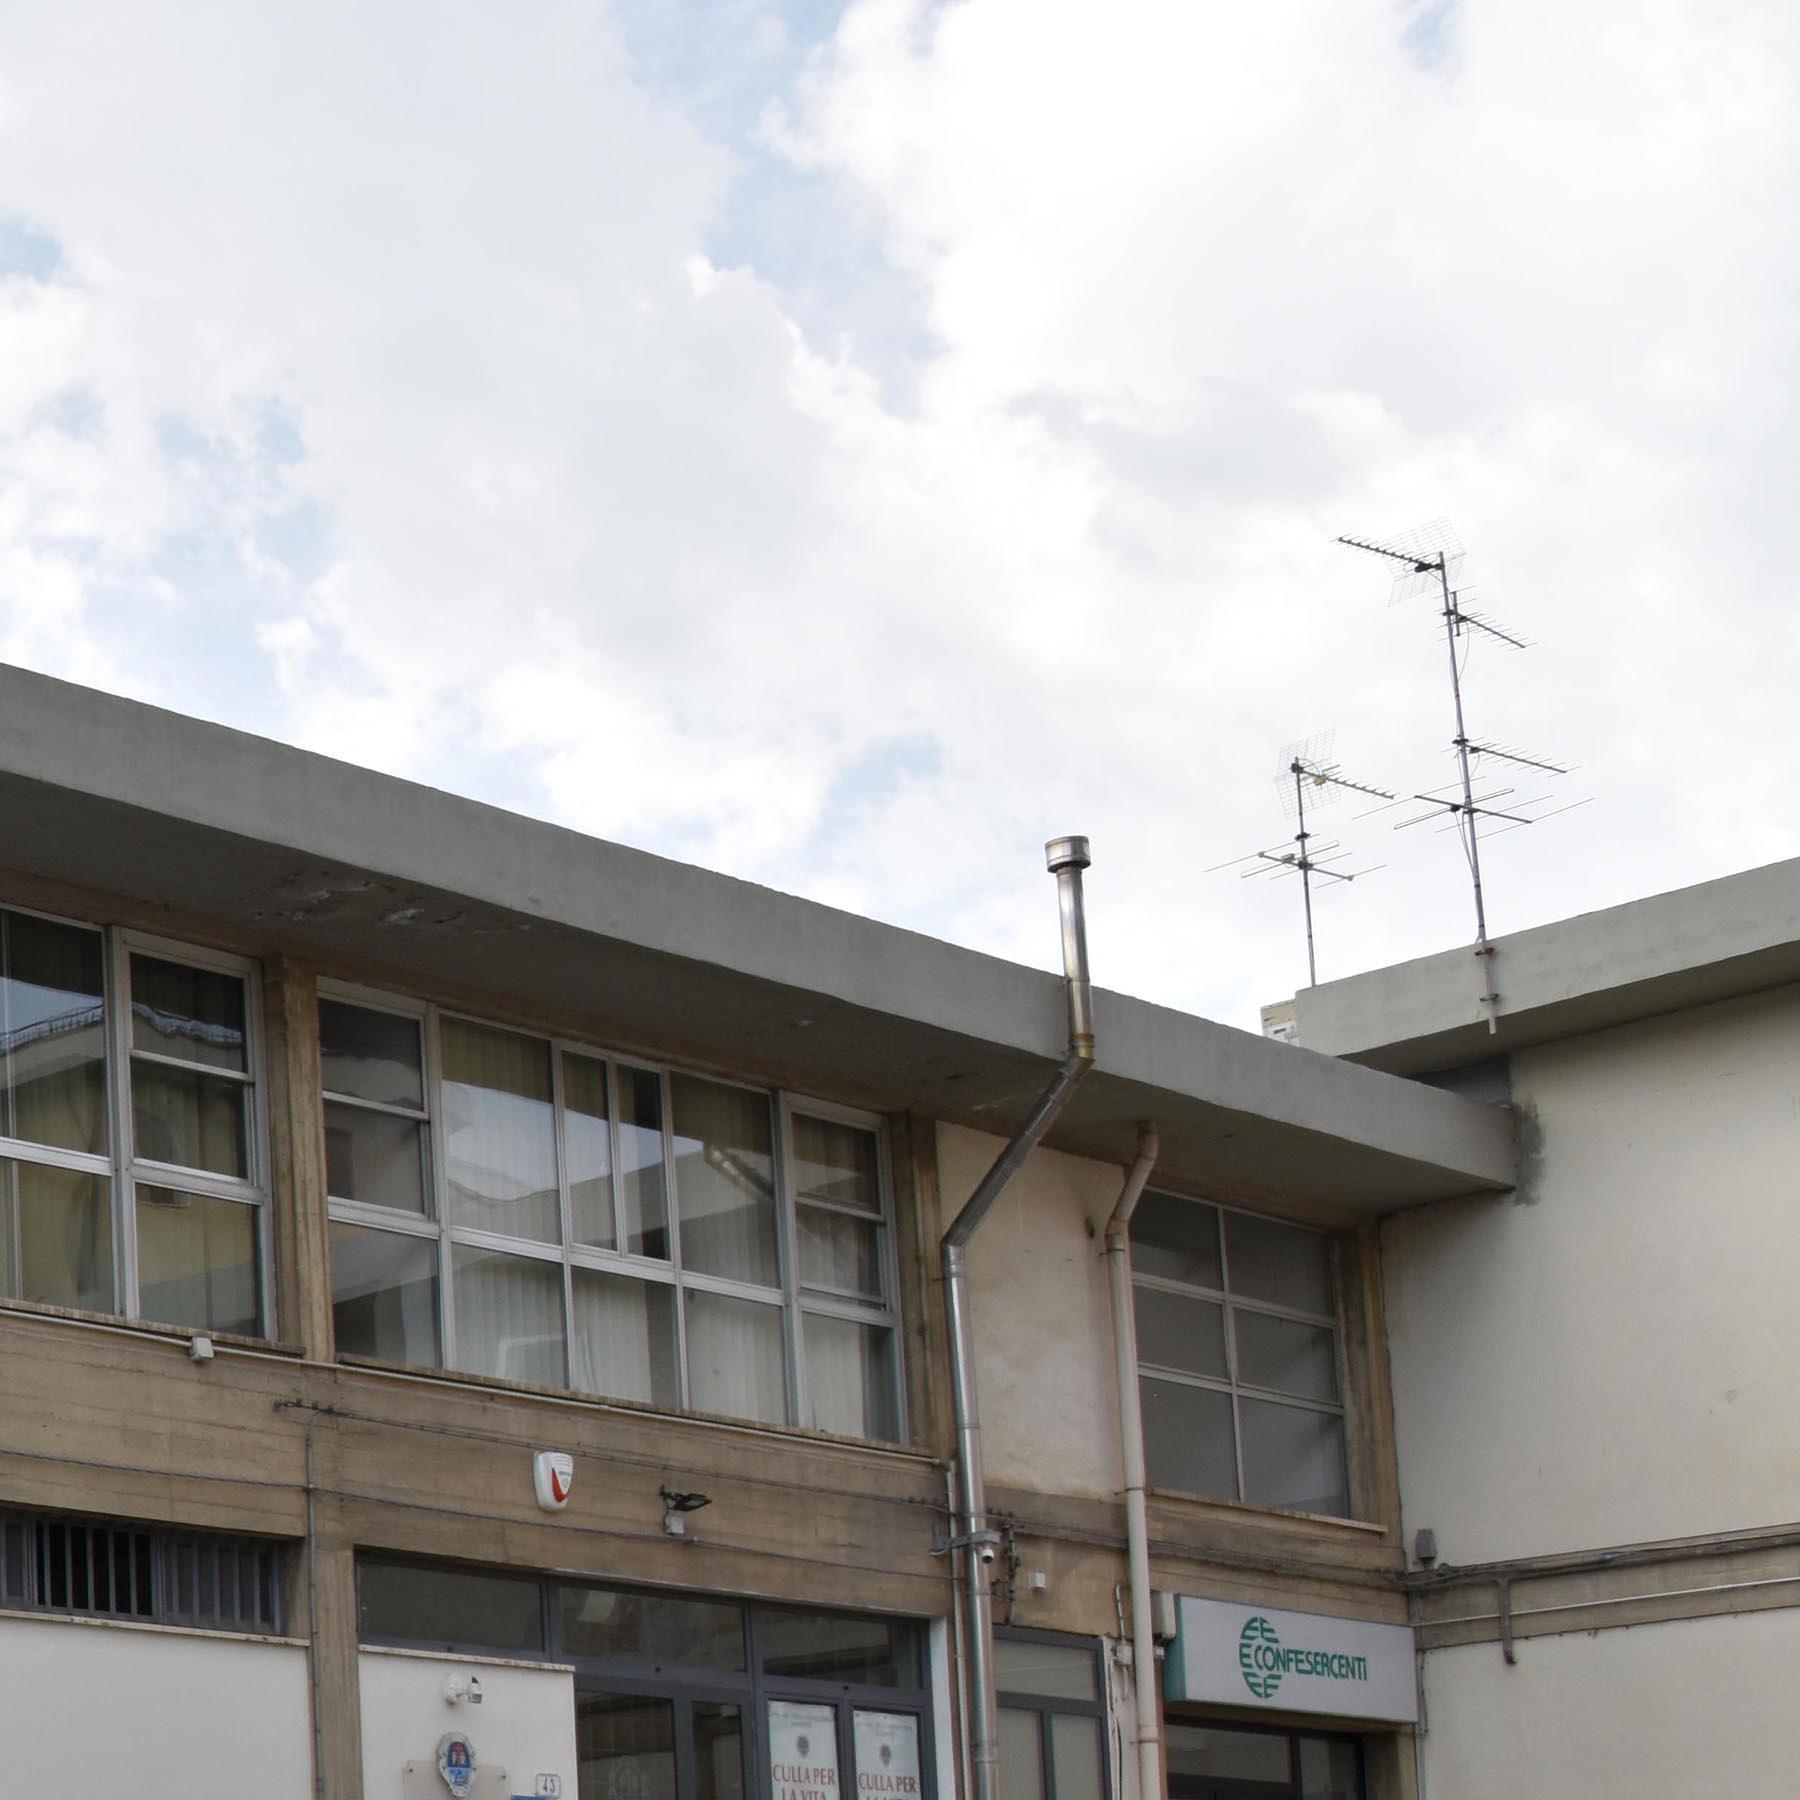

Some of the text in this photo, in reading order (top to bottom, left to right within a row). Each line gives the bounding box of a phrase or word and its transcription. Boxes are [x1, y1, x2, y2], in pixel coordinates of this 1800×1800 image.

[1254, 1644, 1368, 1681] CONFESERCENTI
[772, 1764, 836, 1785] CULLA PER
[858, 1772, 917, 1793] CULLA PER
